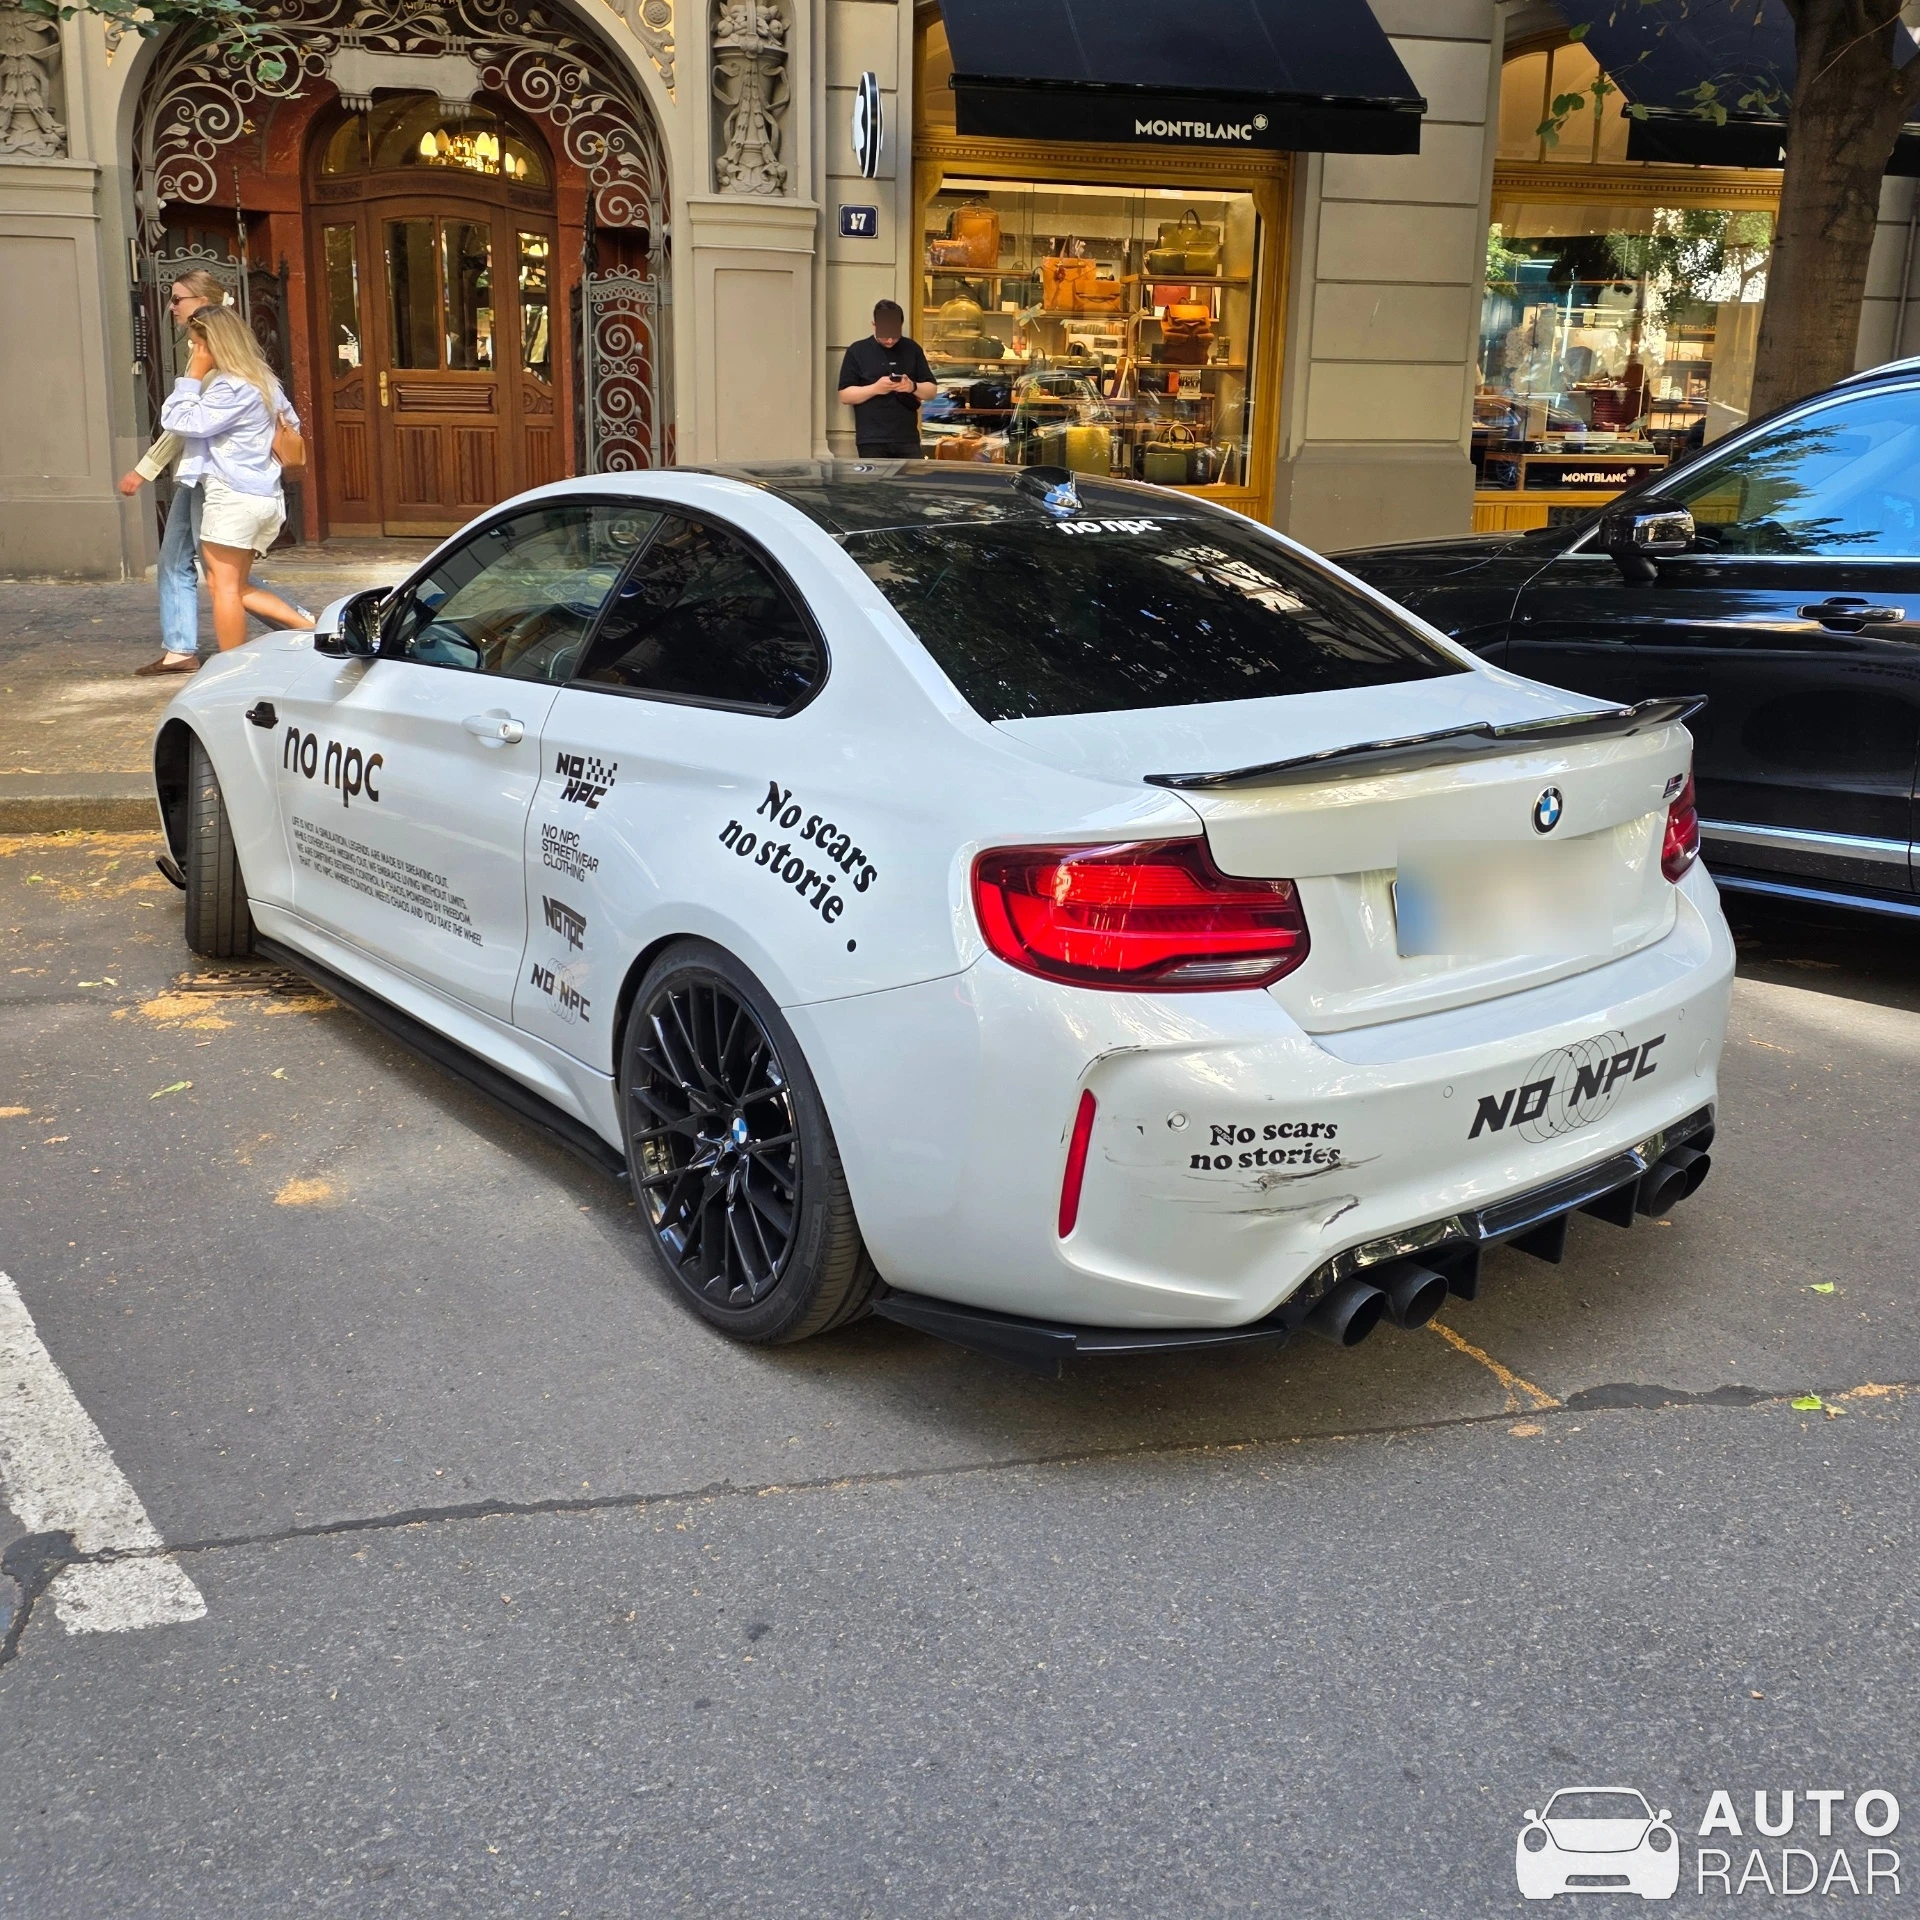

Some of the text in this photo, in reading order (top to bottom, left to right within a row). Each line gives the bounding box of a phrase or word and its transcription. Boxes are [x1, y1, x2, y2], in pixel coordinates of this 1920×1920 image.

[1135, 118, 1252, 141] MONTBLANC
[850, 212, 867, 231] 17
[1561, 472, 1627, 483] MONTBLANC
[1056, 519, 1162, 535] no npc
[283, 726, 384, 808] no npc
[555, 751, 585, 780] NO
[560, 778, 608, 810] NPC
[541, 822, 580, 848] NO NPC
[718, 819, 757, 857] no
[756, 780, 878, 893] No scars
[381, 853, 396, 868] MADE
[397, 859, 404, 870] BY
[405, 862, 434, 882] BREAKING
[541, 838, 599, 873] STREETWEAR
[543, 853, 585, 882] CLOTHING
[355, 867, 380, 887] CONTROL
[406, 889, 432, 909] POWERED
[433, 900, 441, 913] BY
[368, 860, 377, 873] WE
[401, 873, 420, 891] LIVING
[420, 882, 446, 902] WITHOUT
[390, 896, 409, 913] CHAOS
[410, 904, 423, 919] AND
[424, 910, 436, 926] YOU
[437, 916, 451, 933] TAKE
[452, 922, 462, 937] THE
[530, 962, 590, 1023] NO NPC
[1467, 1033, 1666, 1140] NO NPC
[1209, 1122, 1338, 1146] No scars
[1189, 1143, 1341, 1170] no stories
